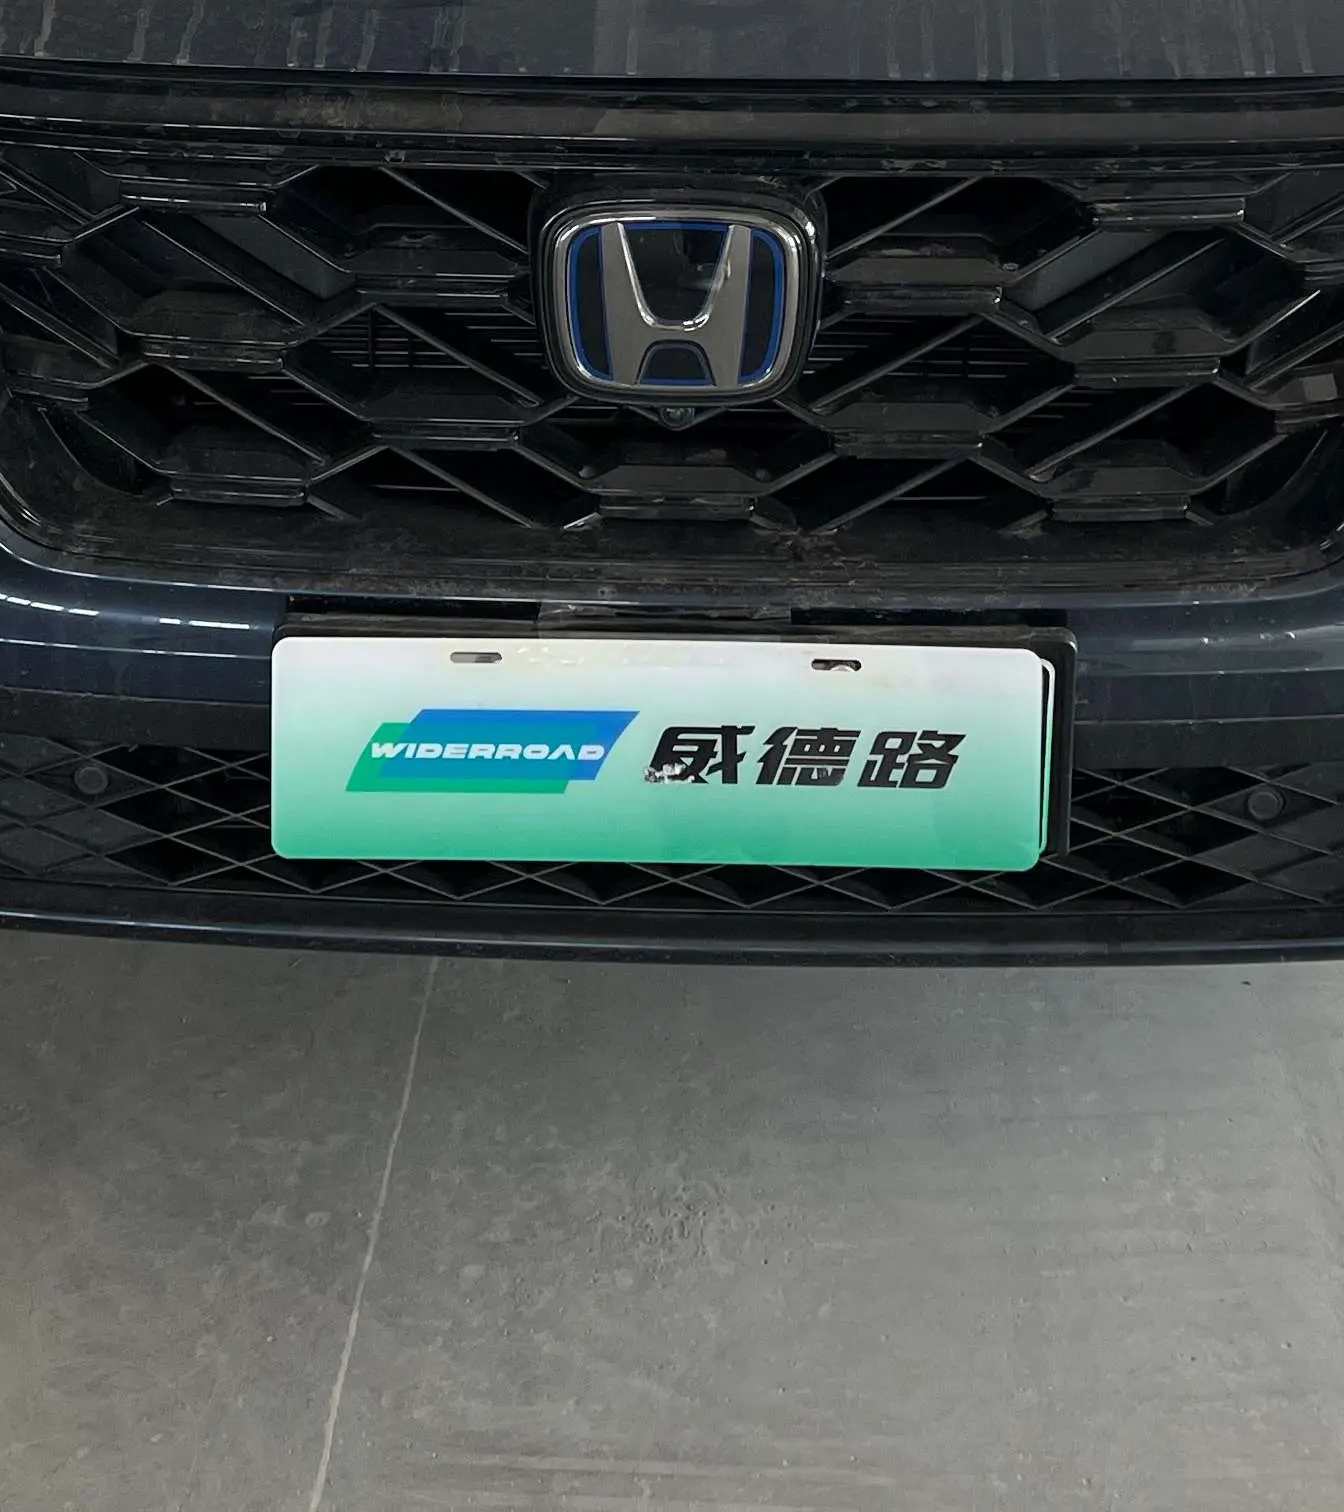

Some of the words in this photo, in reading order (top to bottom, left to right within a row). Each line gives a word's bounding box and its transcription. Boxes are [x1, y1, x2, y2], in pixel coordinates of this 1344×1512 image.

[371, 742, 605, 761] WIDERROAD
[644, 725, 966, 789] 威德路
